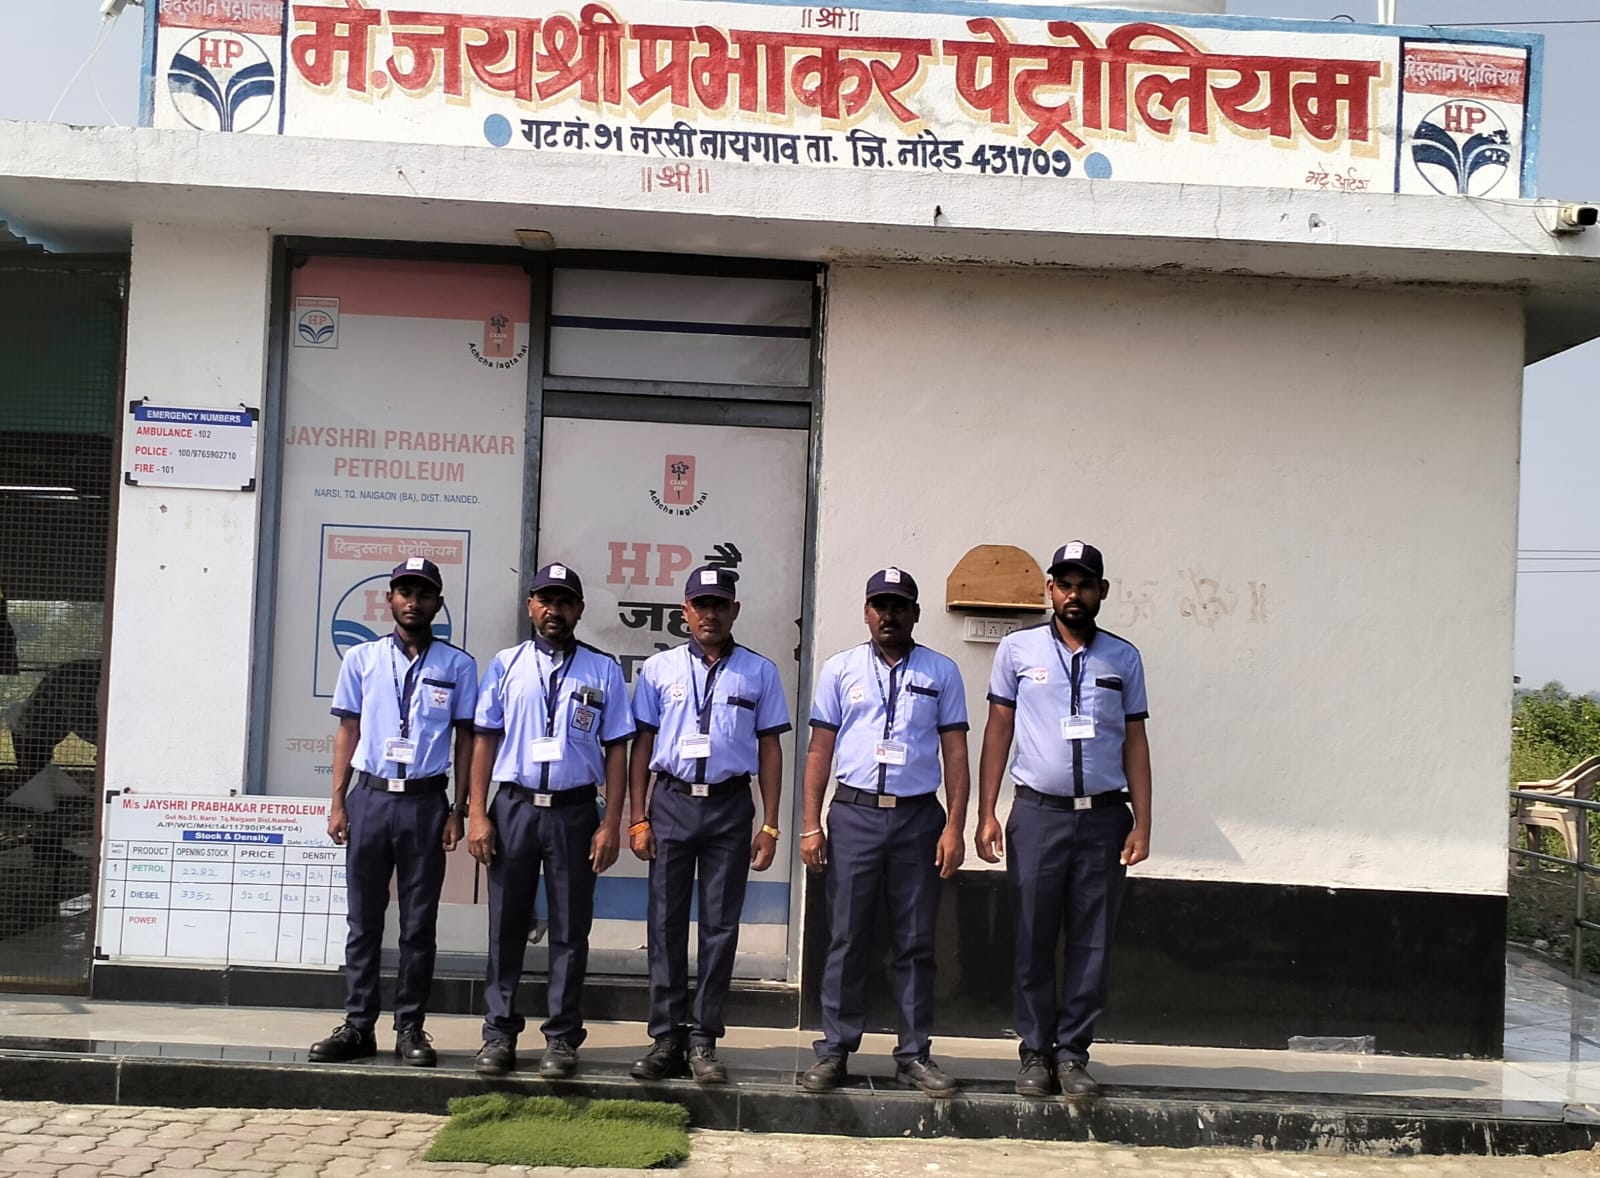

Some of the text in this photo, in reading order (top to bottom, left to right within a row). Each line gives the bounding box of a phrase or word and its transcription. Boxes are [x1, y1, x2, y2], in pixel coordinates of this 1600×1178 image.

[198, 37, 244, 68] HP
[1444, 104, 1486, 134] HP
[146, 410, 241, 423] EMERGENCY NUMBERS
[136, 427, 193, 438] AMBULANCE
[286, 425, 515, 455] JAYSHRI PRABHAKAR
[135, 446, 168, 456] POLICE
[134, 463, 155, 473] FIRE
[334, 457, 465, 482] PETROLEUM
[606, 541, 692, 586] HP
[143, 799, 188, 811] JAYSHRI
[191, 801, 257, 813] PRABHAKAR
[260, 804, 326, 816] PETROLEUM
[195, 831, 270, 843] Stock & Density
[132, 846, 169, 856] PRODUCT
[176, 847, 229, 857] OPENING STOCK
[240, 850, 276, 859] PRICE
[302, 851, 338, 860] DENSITY
[132, 864, 166, 873] PETROL
[110, 889, 117, 898] 2
[130, 890, 160, 900] DIESEL
[129, 916, 157, 925] POWER
